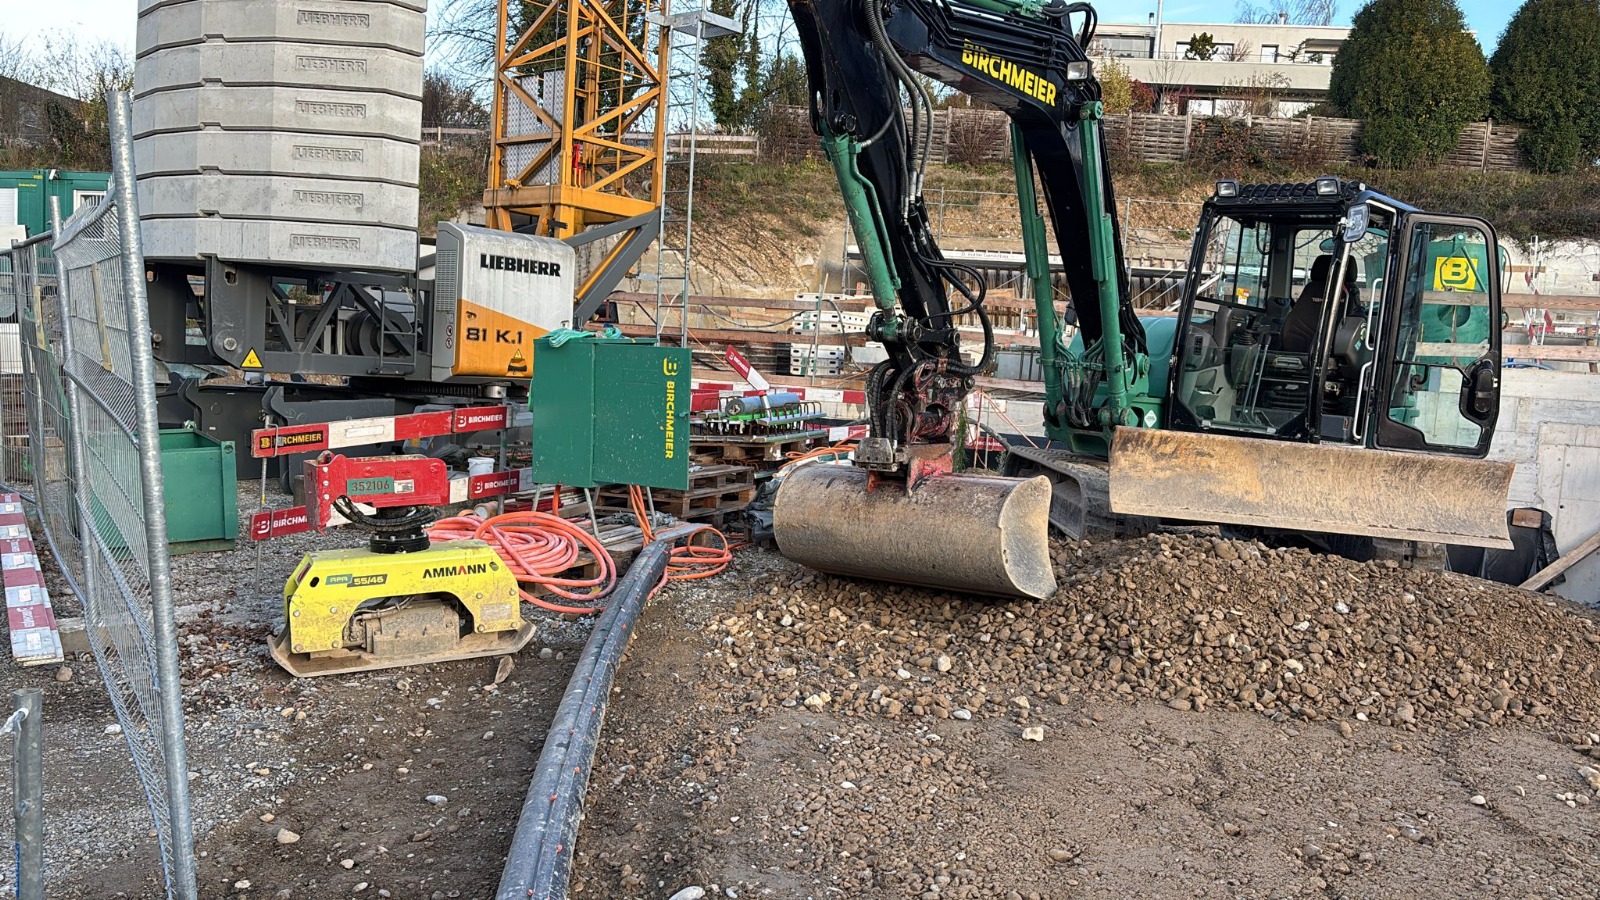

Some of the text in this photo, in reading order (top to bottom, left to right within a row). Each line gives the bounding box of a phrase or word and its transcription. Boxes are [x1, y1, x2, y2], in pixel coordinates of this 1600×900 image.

[300, 12, 368, 27] LIEBHERR
[298, 57, 365, 72] LIEBHERR
[962, 38, 1057, 107] BIRCHMEIER
[297, 102, 364, 117] LIEBHERR
[295, 147, 361, 161] LIEBHERR
[295, 191, 361, 206] LIEBHERR
[292, 236, 359, 250] LIEBHERR
[480, 253, 561, 277] LIEBHERR
[466, 327, 522, 344] 81 K.1
[468, 414, 503, 424] BIRCHMEIER
[665, 381, 675, 459] BIRCHMEIER
[273, 433, 322, 446] RCHMEIER
[351, 480, 390, 492] 352106
[484, 478, 517, 490] BIRCHMEER
[273, 515, 308, 528] BIRCHM
[422, 563, 487, 579] AMMANN
